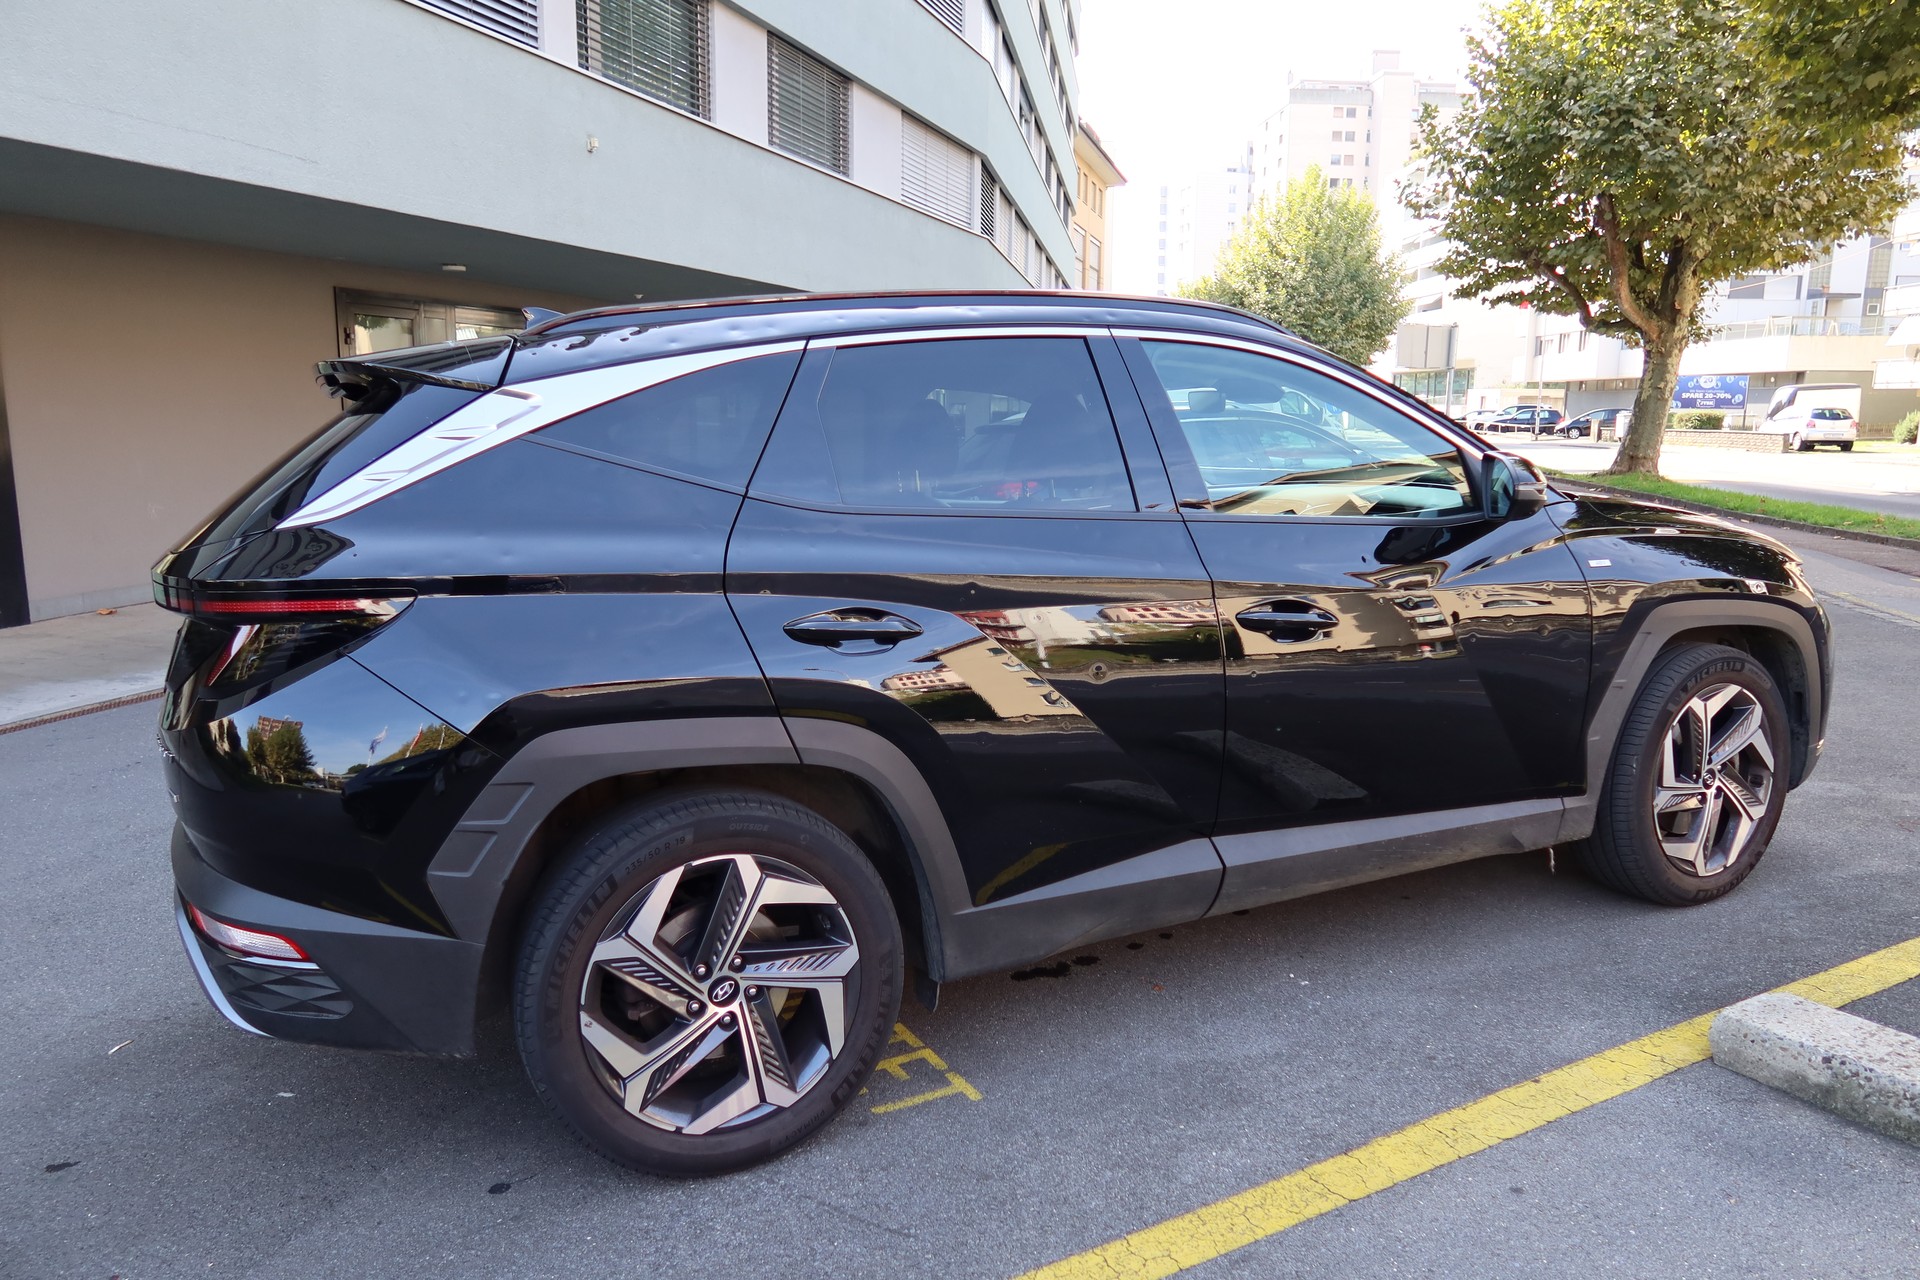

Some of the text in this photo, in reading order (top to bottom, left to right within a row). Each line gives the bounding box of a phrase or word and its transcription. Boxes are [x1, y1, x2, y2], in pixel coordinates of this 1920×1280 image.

[1686, 661, 1743, 690] MICHELIN
[729, 822, 770, 833] OUTSIDE
[624, 835, 686, 876] 235/50 R 19
[545, 880, 613, 1009] MICHELIN
[836, 985, 893, 1101] MICHELIN
[784, 1109, 826, 1143] PRIMACY
